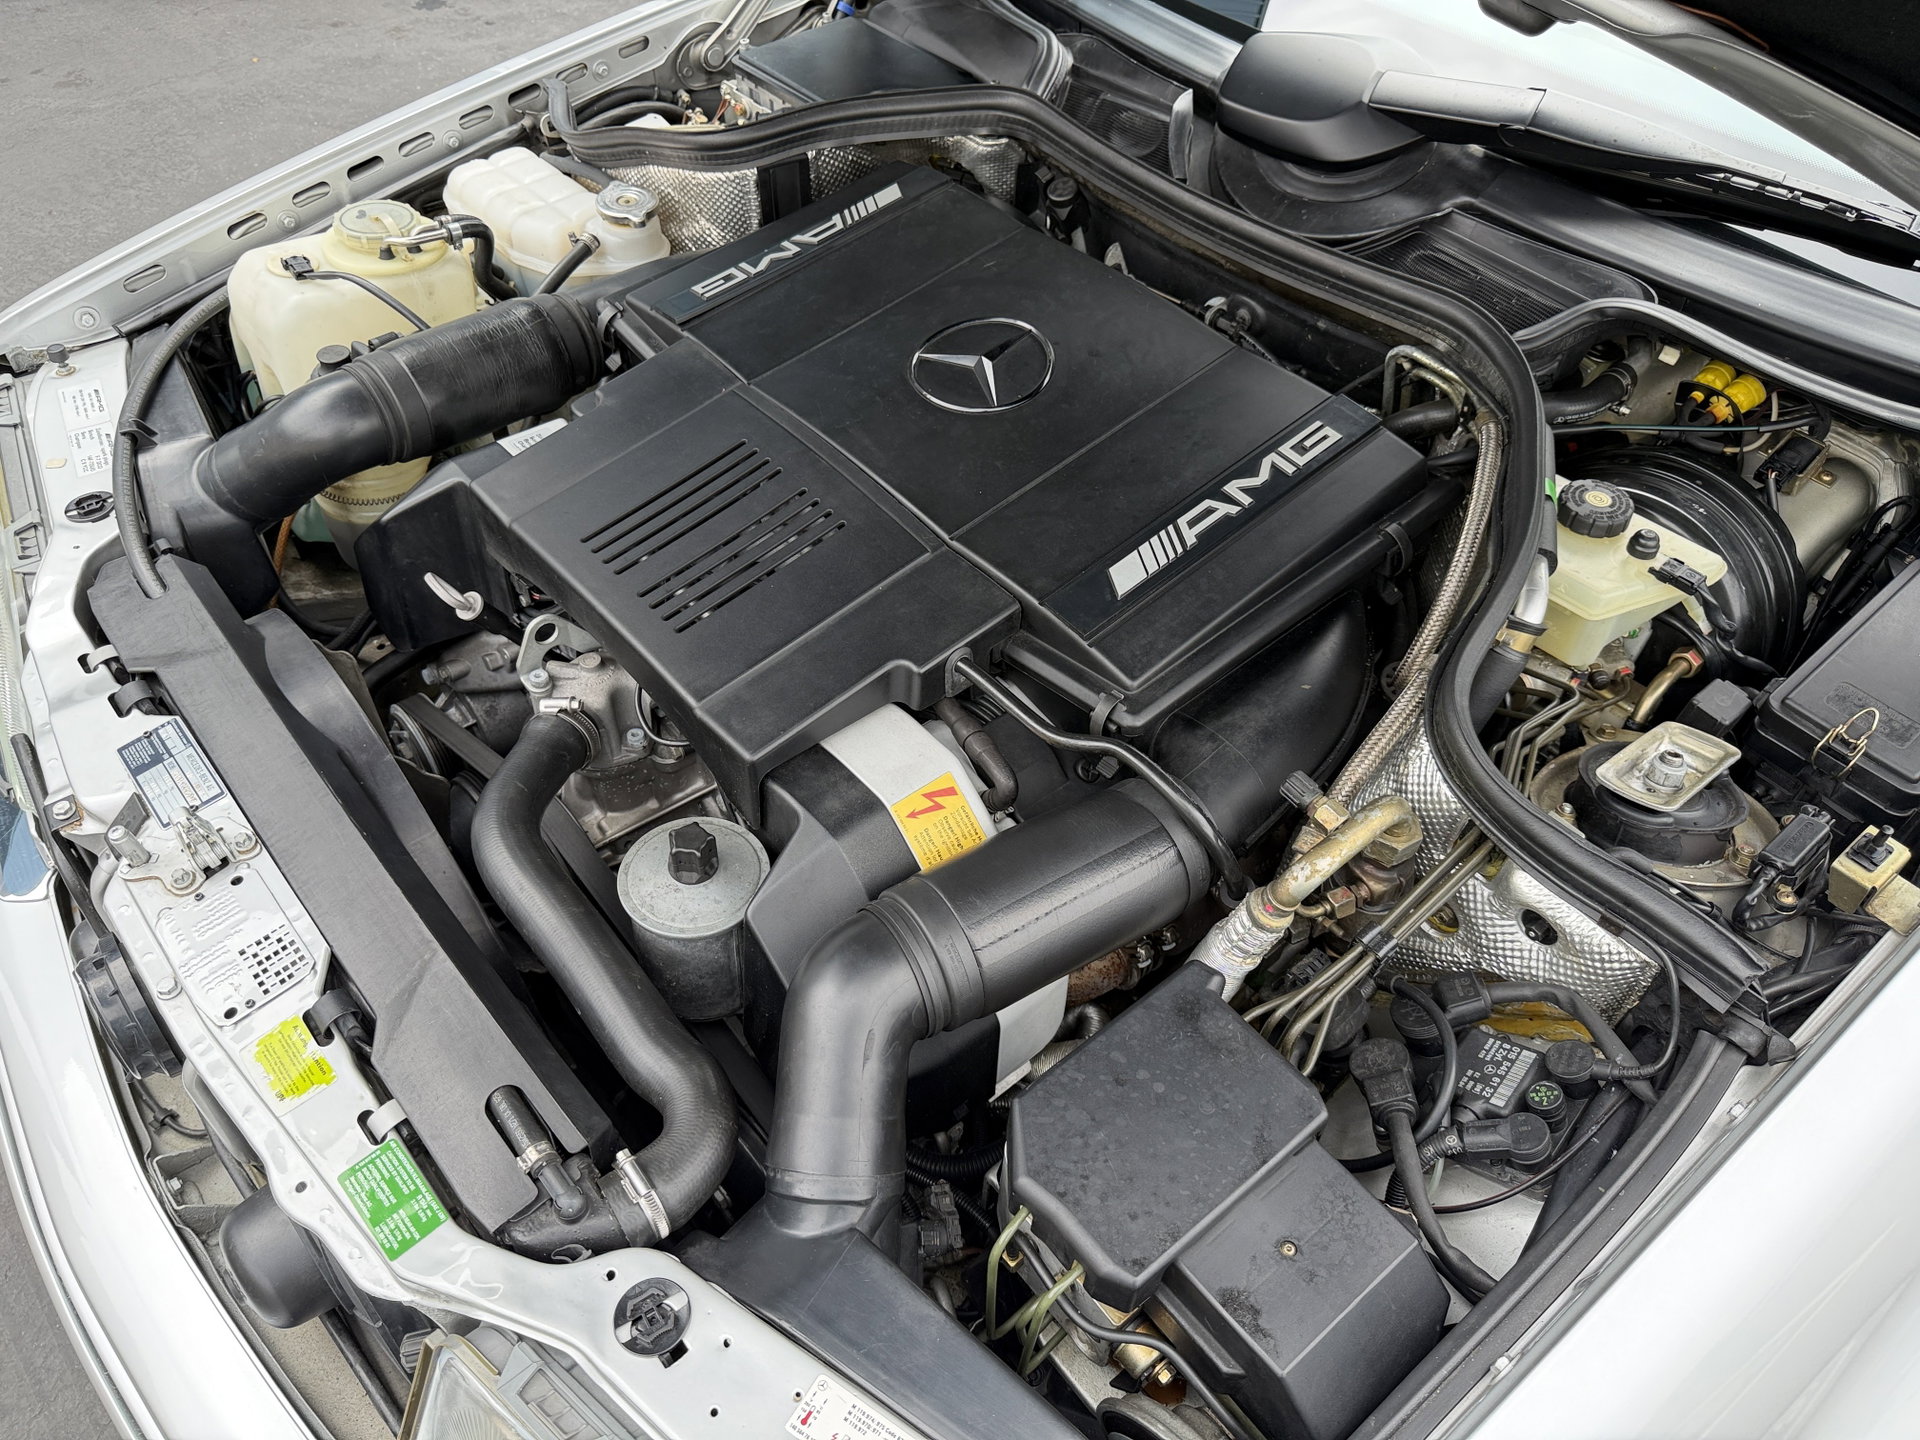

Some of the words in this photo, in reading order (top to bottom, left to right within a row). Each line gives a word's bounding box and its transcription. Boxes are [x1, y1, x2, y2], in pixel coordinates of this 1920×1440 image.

[1176, 420, 1343, 550] AMG
[1492, 1047, 1507, 1063] Zyl.
[1507, 1045, 1520, 1060] 015
[1496, 1060, 1511, 1076] 545
[1489, 1076, 1500, 1087] 61
[1482, 1086, 1494, 1098] 32
